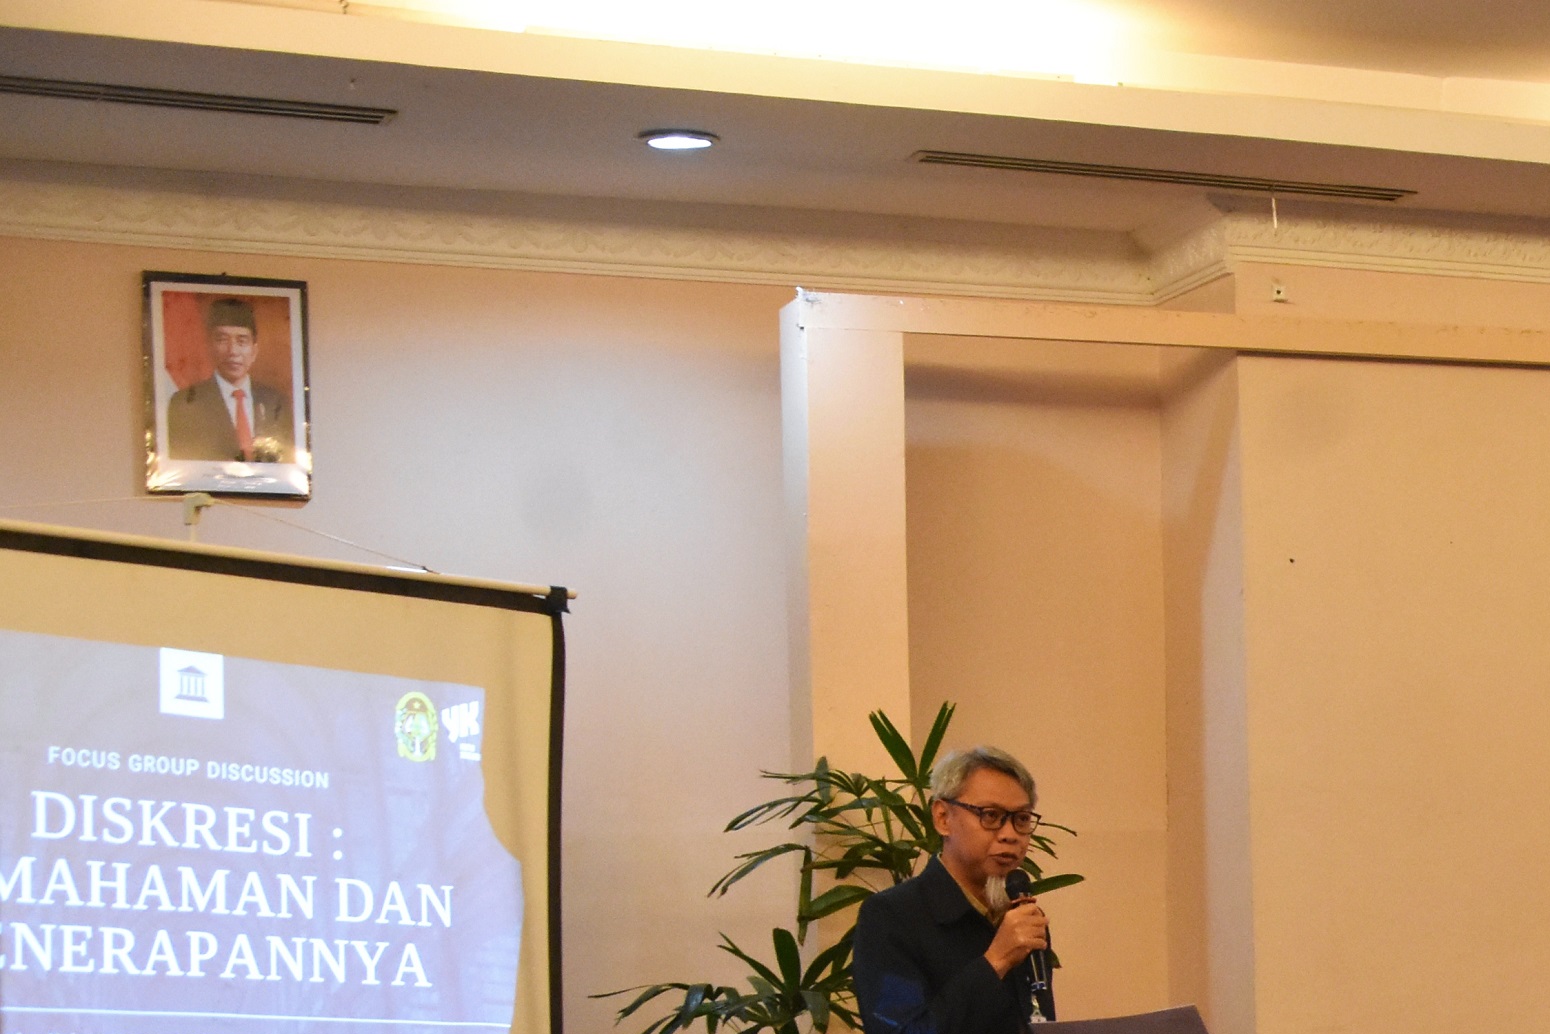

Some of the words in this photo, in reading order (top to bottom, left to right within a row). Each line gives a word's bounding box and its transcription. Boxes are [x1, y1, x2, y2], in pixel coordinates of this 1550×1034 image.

[48, 746, 121, 770] FOCUS
[128, 754, 200, 776] GROUP
[207, 761, 329, 789] DISCUSSION
[31, 790, 312, 858] DISKRESI
[335, 877, 454, 928] DAN
[0, 921, 433, 988] NERAPANNYA
